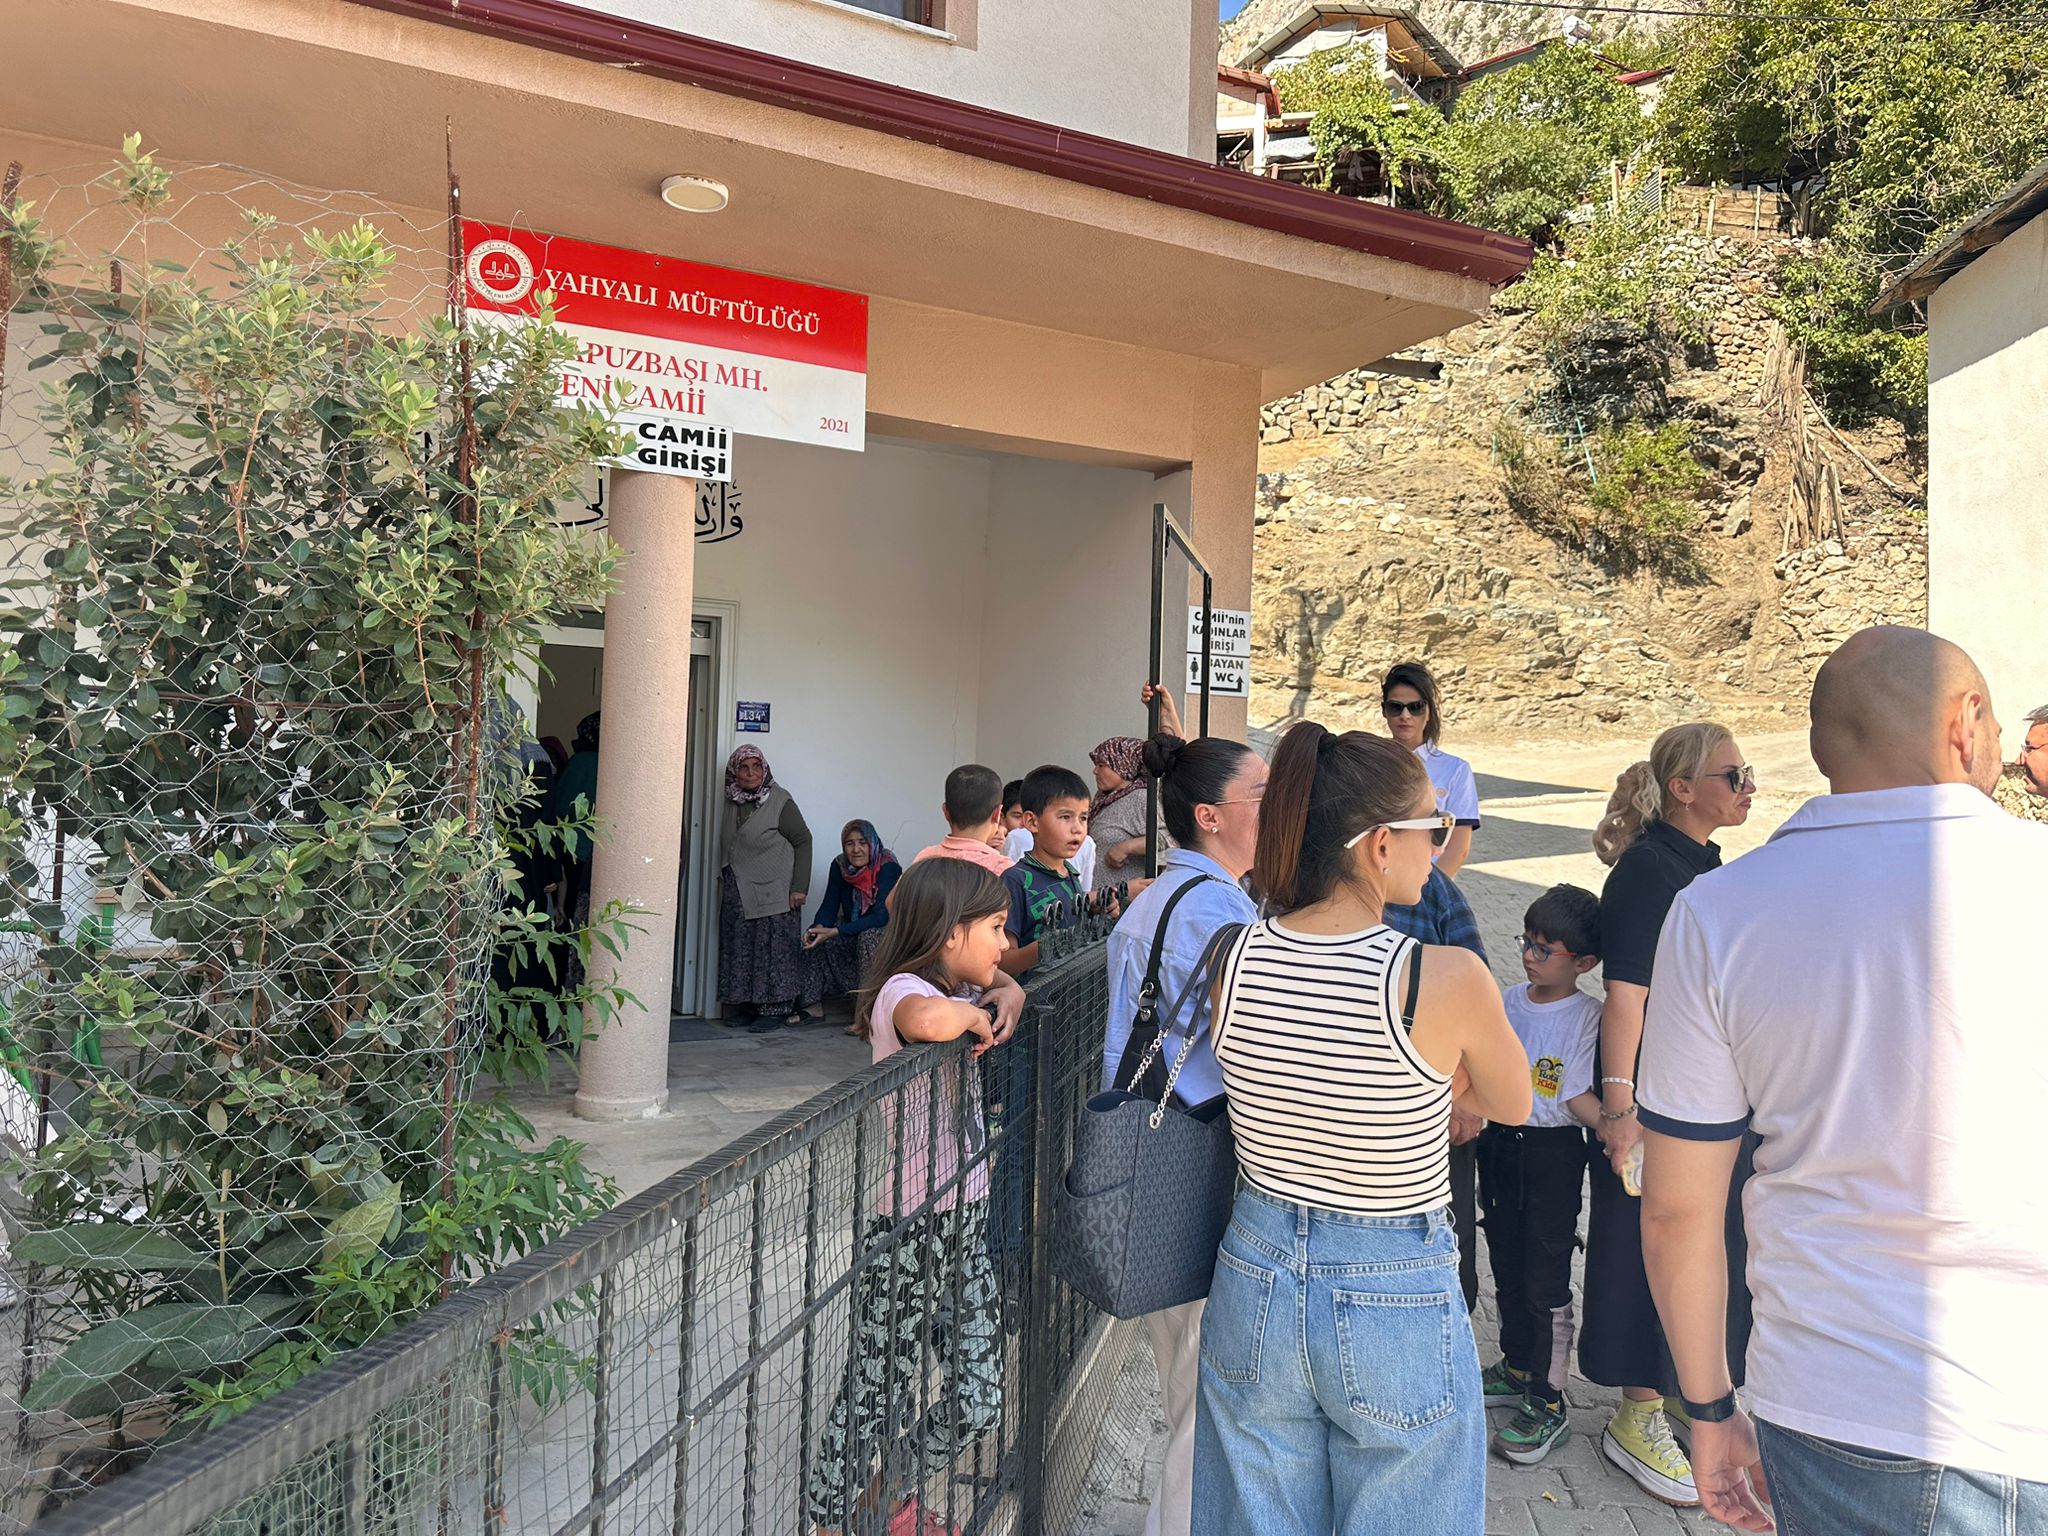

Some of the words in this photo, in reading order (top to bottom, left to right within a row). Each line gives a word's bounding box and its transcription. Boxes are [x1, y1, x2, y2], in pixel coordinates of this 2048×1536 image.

[544, 269, 658, 306] YAHYALI
[667, 290, 820, 335] MÜFTÜLÜĞÜ
[575, 342, 708, 385] PUZBAŞI
[715, 363, 768, 392] MH.
[562, 374, 612, 400] ENİ
[638, 423, 726, 449] CAMİİ
[820, 417, 848, 433] 2021
[638, 445, 726, 477] GİRİŞİ
[1194, 611, 1244, 625] CMİİ'nin
[1210, 637, 1235, 653] İRİŞİ
[1215, 672, 1234, 682] WC
